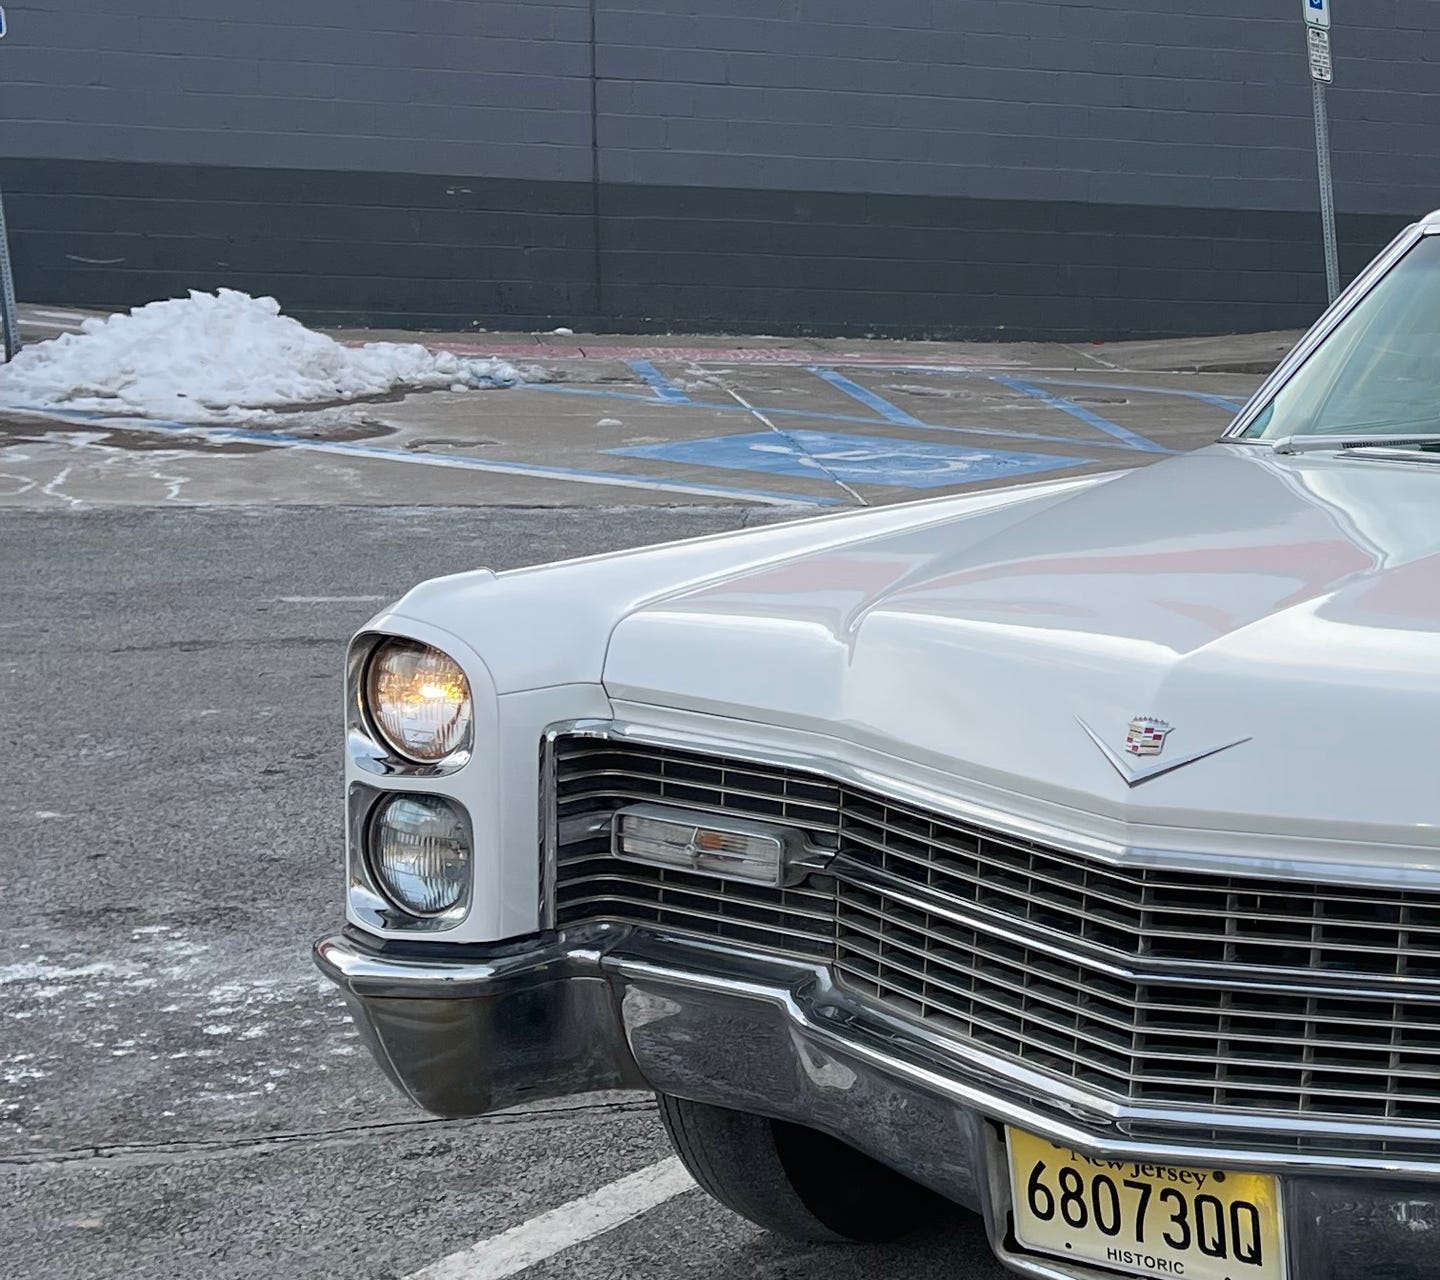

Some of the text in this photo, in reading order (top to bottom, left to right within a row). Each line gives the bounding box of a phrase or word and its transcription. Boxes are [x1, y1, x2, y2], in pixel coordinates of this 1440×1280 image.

[1130, 1163, 1208, 1191] Jersey
[1027, 1159, 1263, 1268] 68073QQ
[1107, 1246, 1186, 1276] HISTORIC
